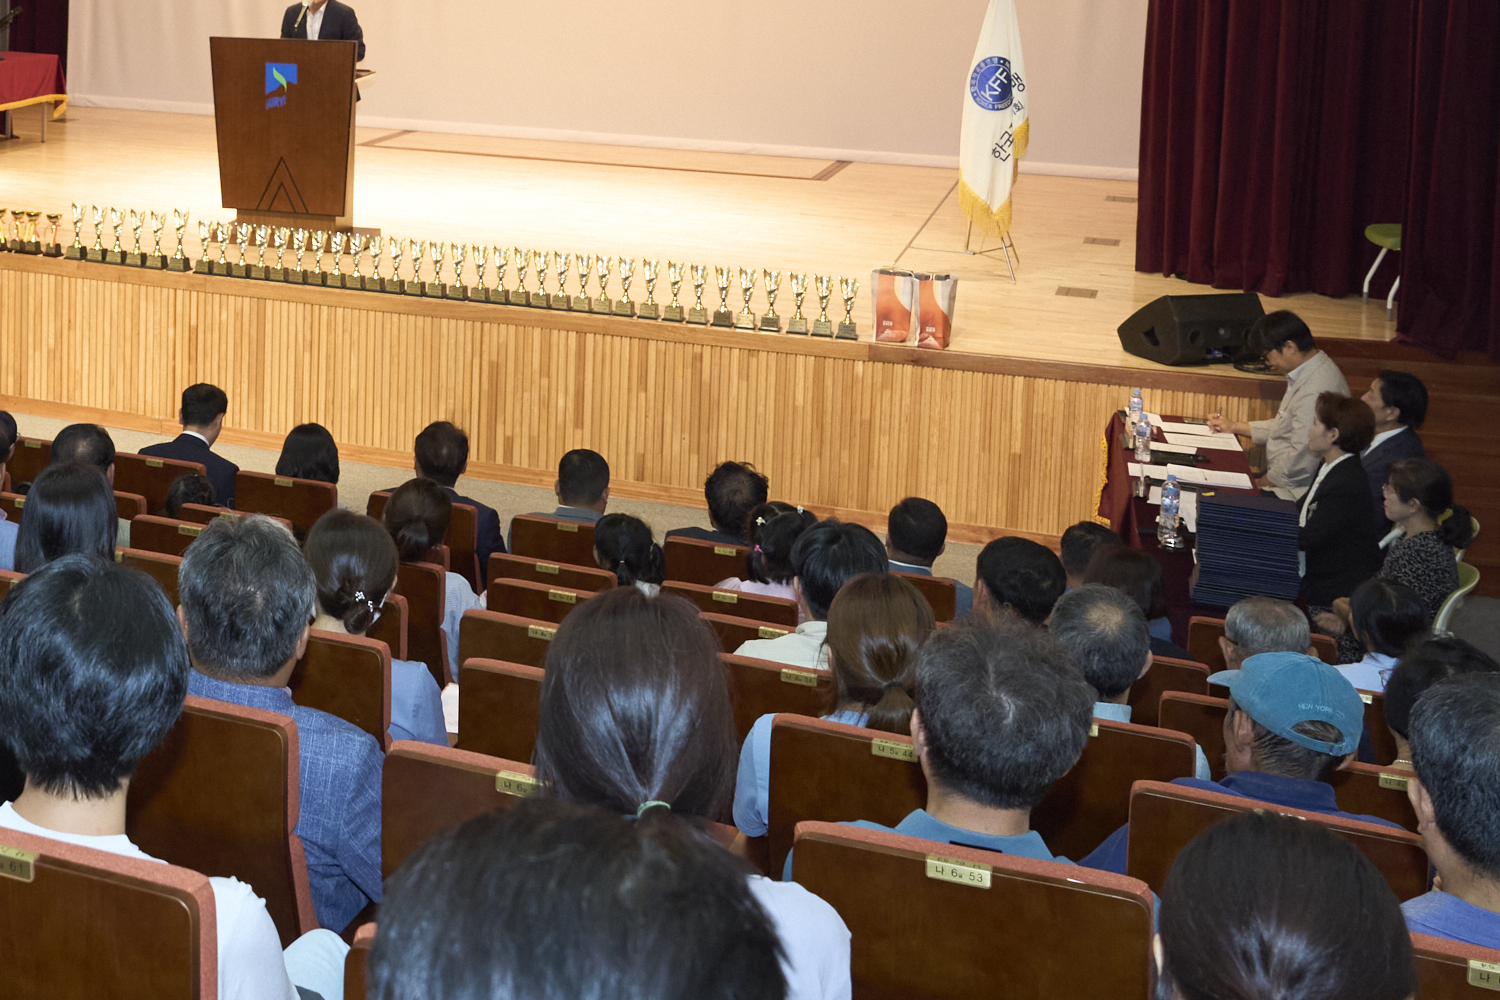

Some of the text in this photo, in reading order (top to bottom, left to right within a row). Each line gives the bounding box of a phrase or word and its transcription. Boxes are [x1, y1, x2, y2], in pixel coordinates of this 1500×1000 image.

[980, 67, 1008, 102] KFF
[935, 865, 945, 876] 나
[969, 871, 983, 883] 53
